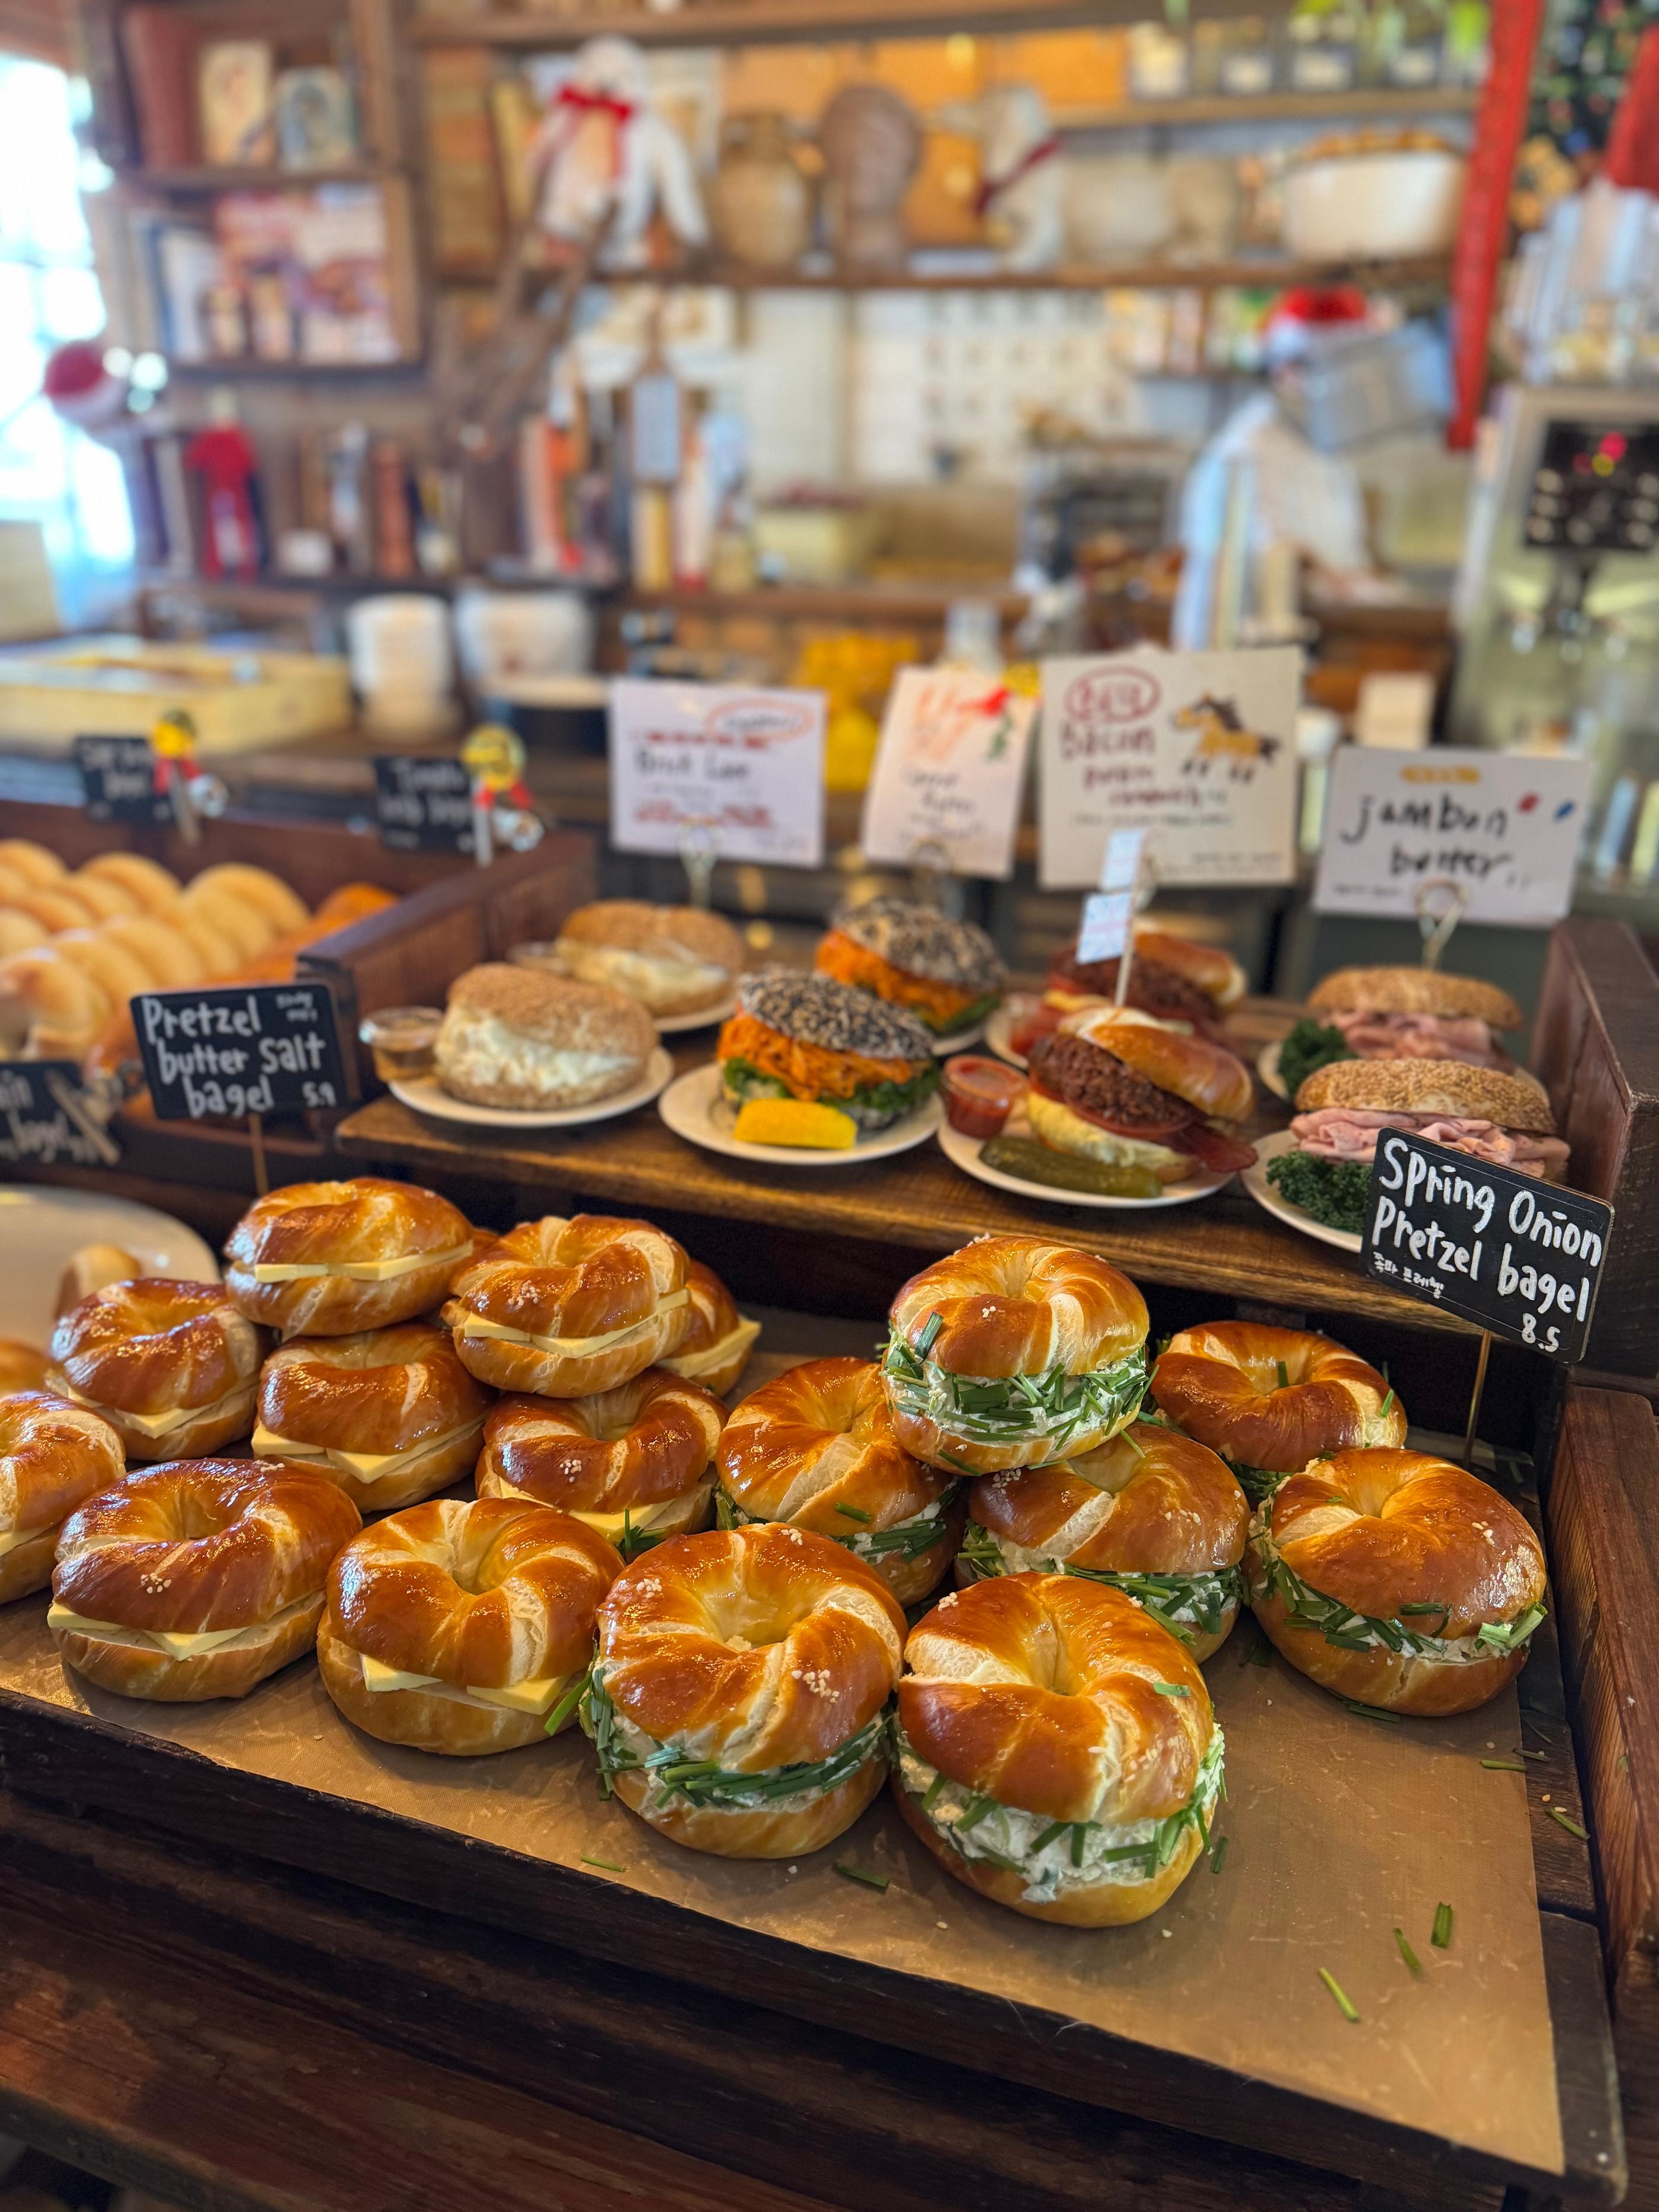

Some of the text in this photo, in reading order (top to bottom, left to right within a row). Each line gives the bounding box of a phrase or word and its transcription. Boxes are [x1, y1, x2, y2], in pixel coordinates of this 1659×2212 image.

[141, 994, 262, 1044] Pretzel
[156, 1037, 249, 1085] butter
[182, 1073, 274, 1119] bagel
[1379, 1138, 1602, 1267] Spring Onion
[1372, 1195, 1589, 1322] Pretzel bagel
[1521, 1313, 1561, 1353] 8.5
